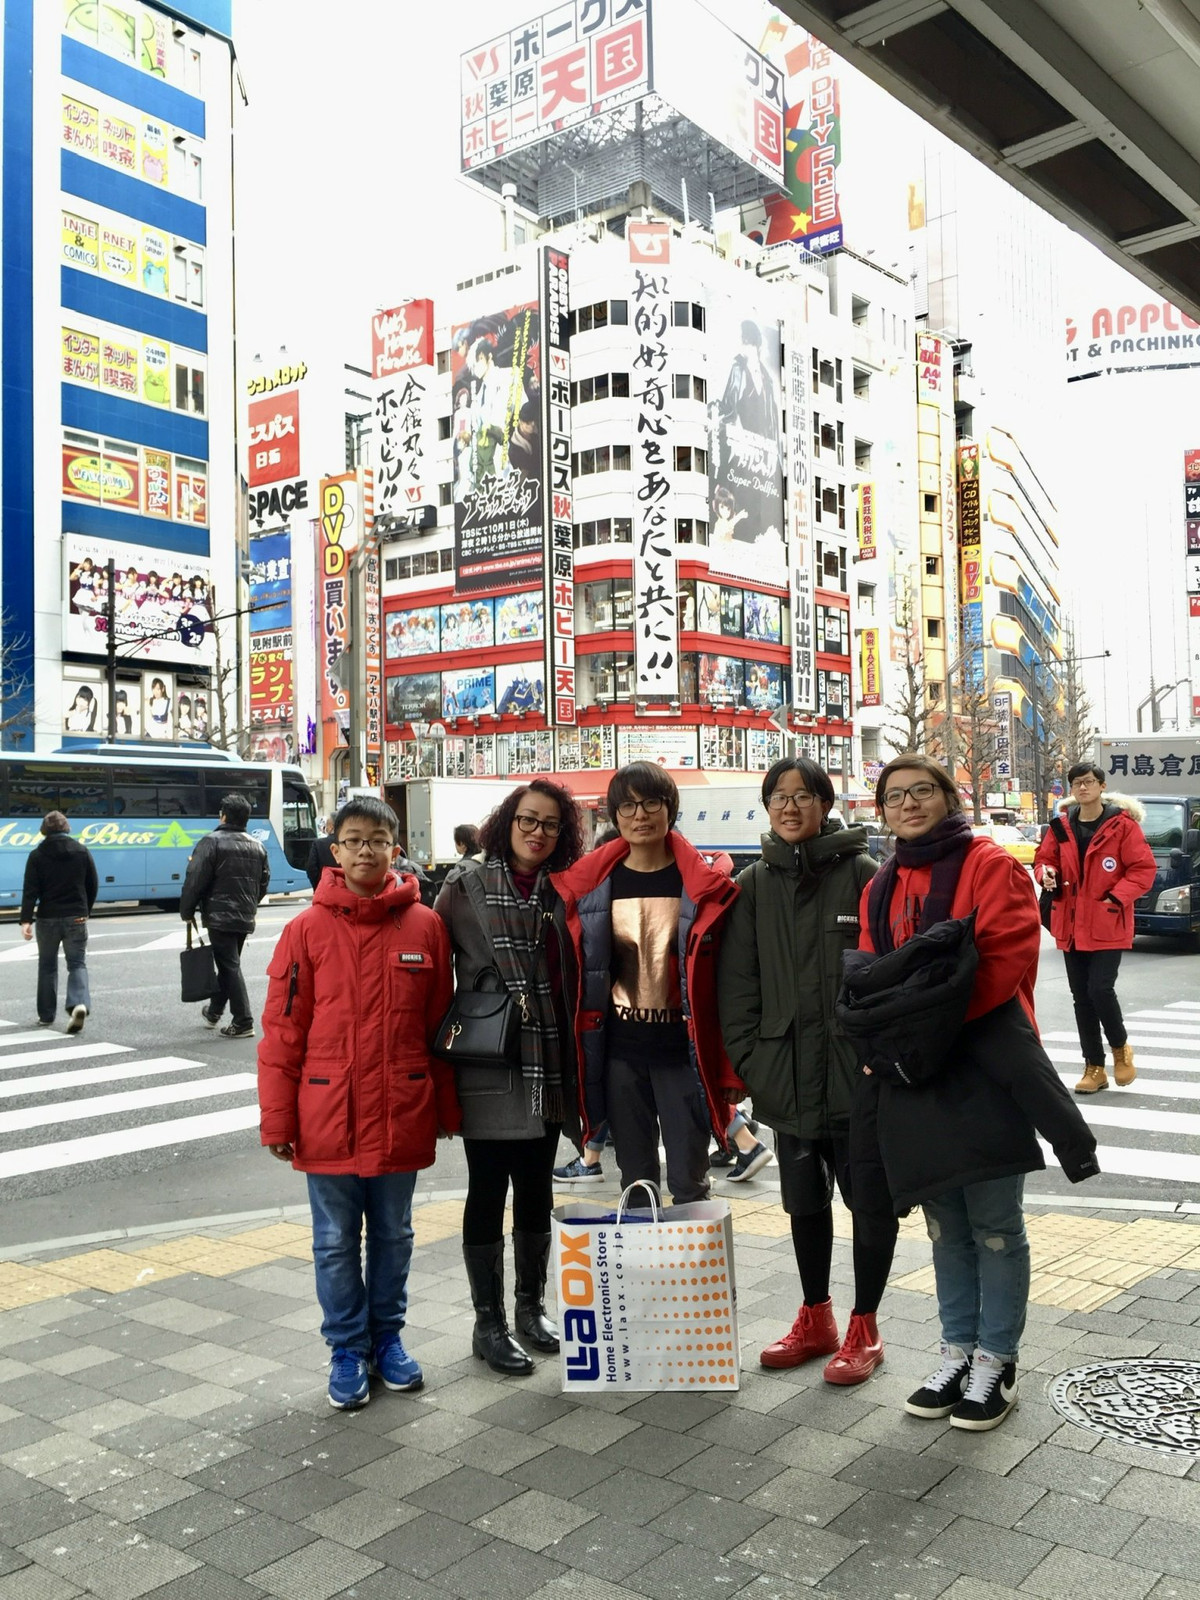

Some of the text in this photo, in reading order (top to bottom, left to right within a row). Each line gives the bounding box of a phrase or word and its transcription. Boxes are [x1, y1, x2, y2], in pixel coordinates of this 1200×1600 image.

[541, 19, 643, 120] 天国
[465, 67, 535, 120] 秋葉原
[811, 75, 836, 224] DUTY FREE
[63, 244, 96, 266] COMICS
[74, 235, 84, 247] &
[1087, 343, 1103, 358] &
[552, 380, 571, 492] ボークス
[726, 468, 752, 488] Super
[963, 490, 977, 499] CD
[249, 481, 308, 521] SPACE
[962, 508, 979, 518] アニメ
[553, 495, 572, 579] 秋葉原
[964, 561, 982, 599] DVD
[554, 583, 577, 723] ホビー天国
[456, 675, 492, 690] PRIME
[79, 822, 158, 846] Bus
[597, 1232, 617, 1382] Home Electronics Store
